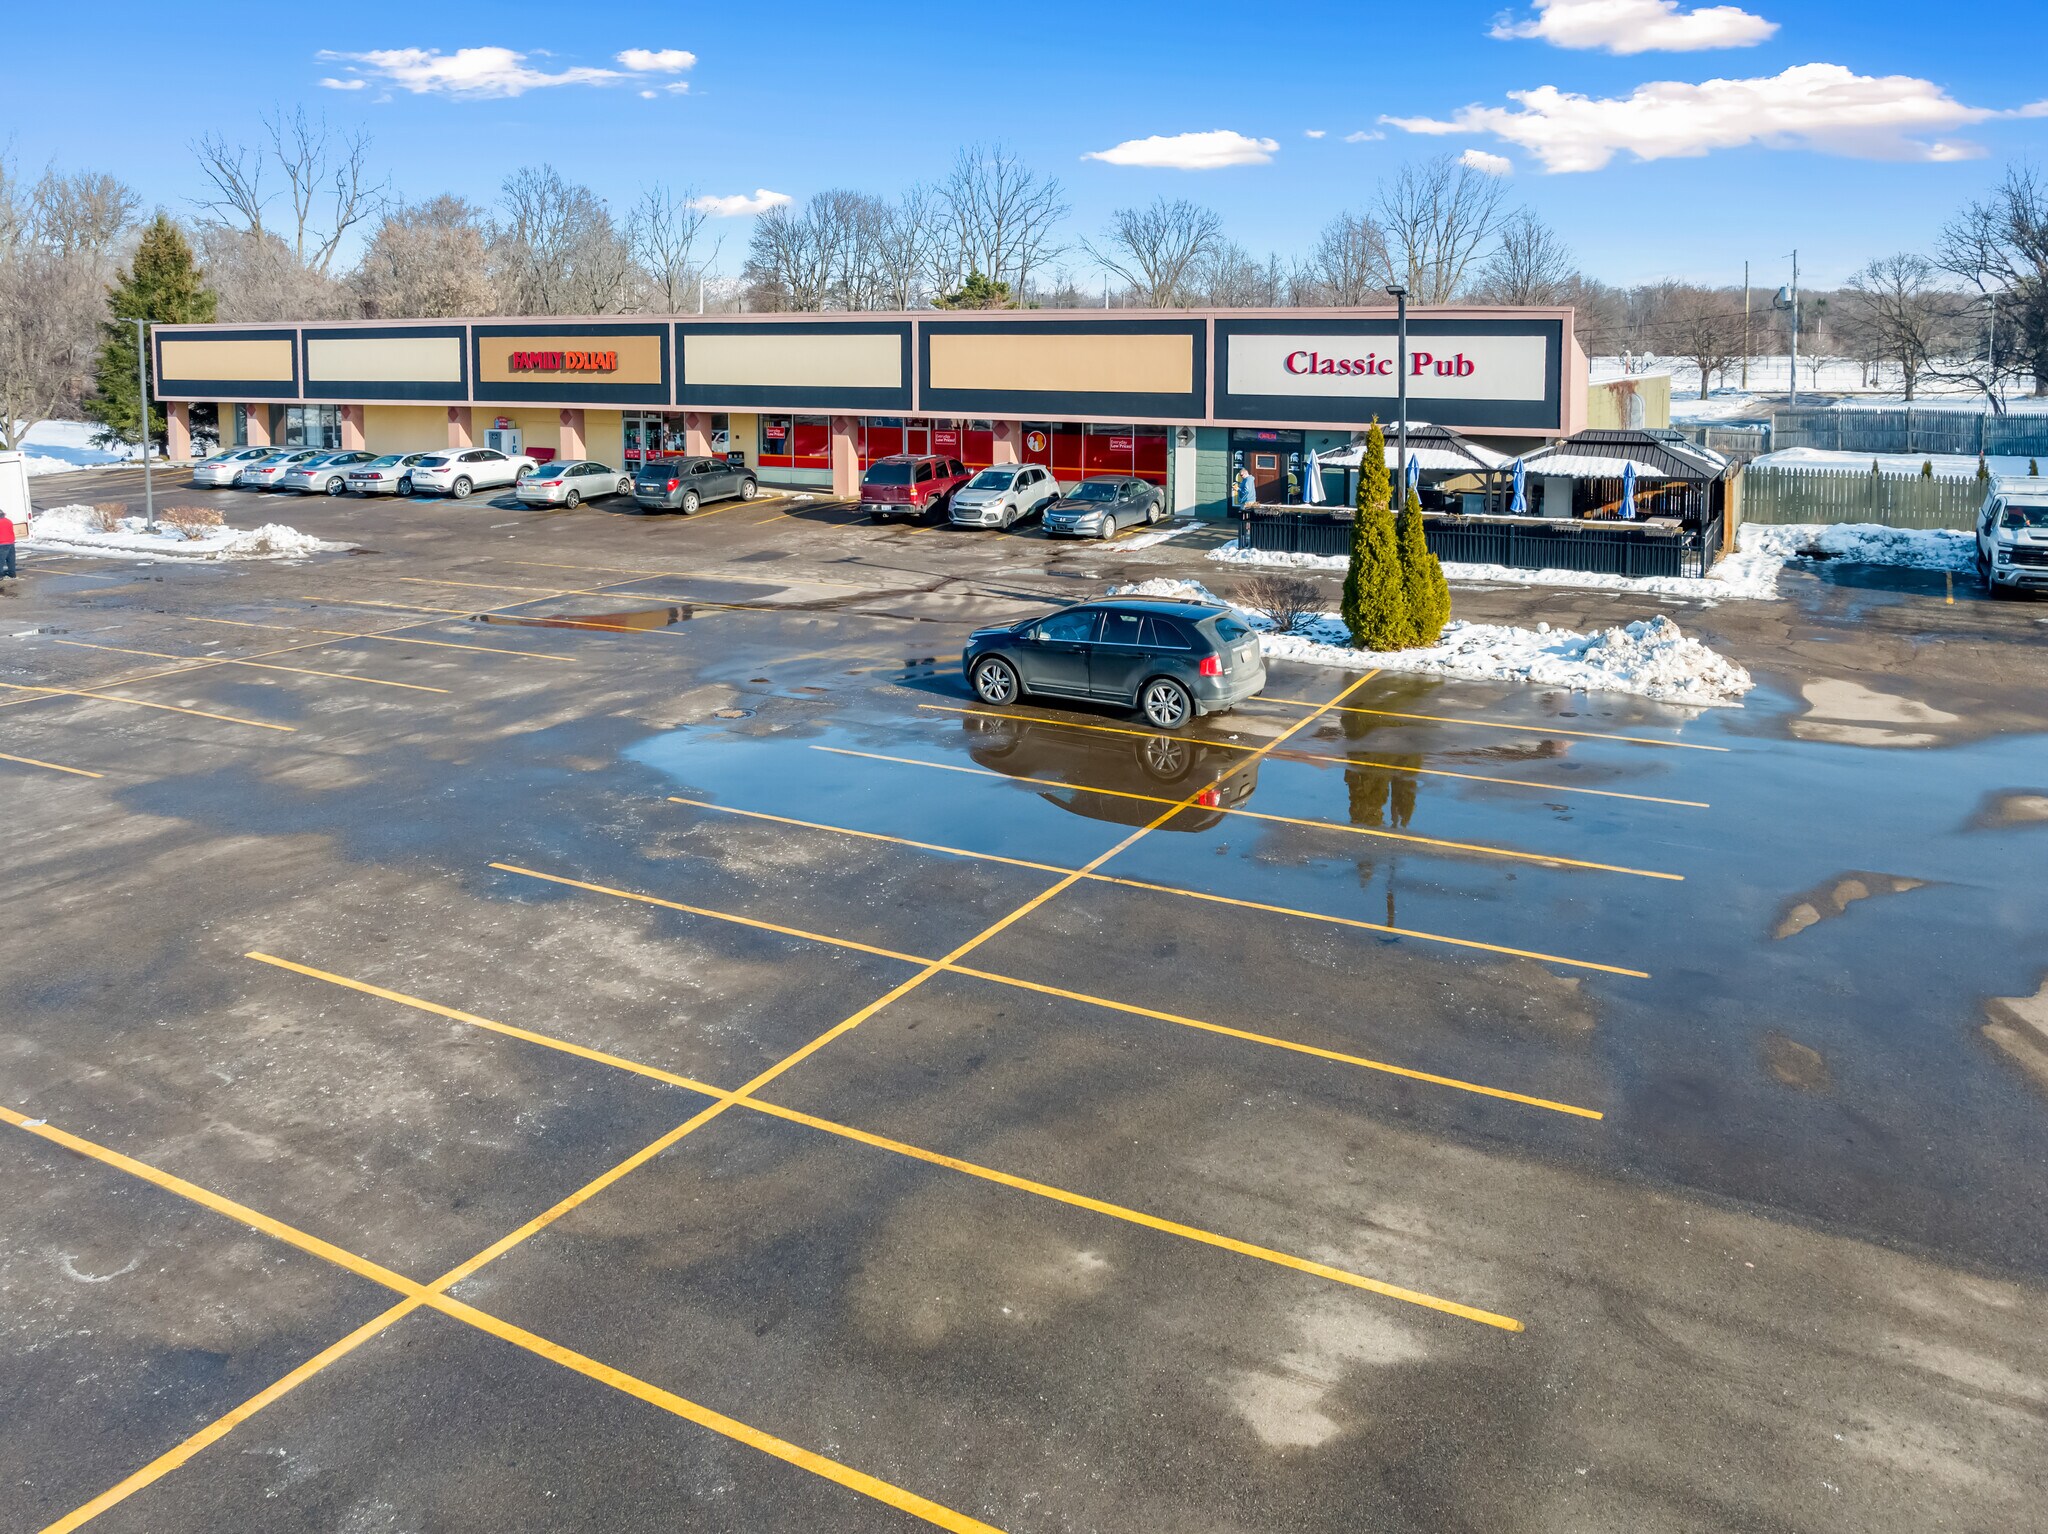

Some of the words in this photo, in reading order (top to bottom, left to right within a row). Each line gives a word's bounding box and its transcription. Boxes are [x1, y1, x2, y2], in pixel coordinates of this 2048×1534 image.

[513, 351, 563, 369] FAMILY
[565, 351, 617, 370] DOLLAR
[1285, 350, 1393, 376] Classic
[1410, 352, 1475, 377] Pub
